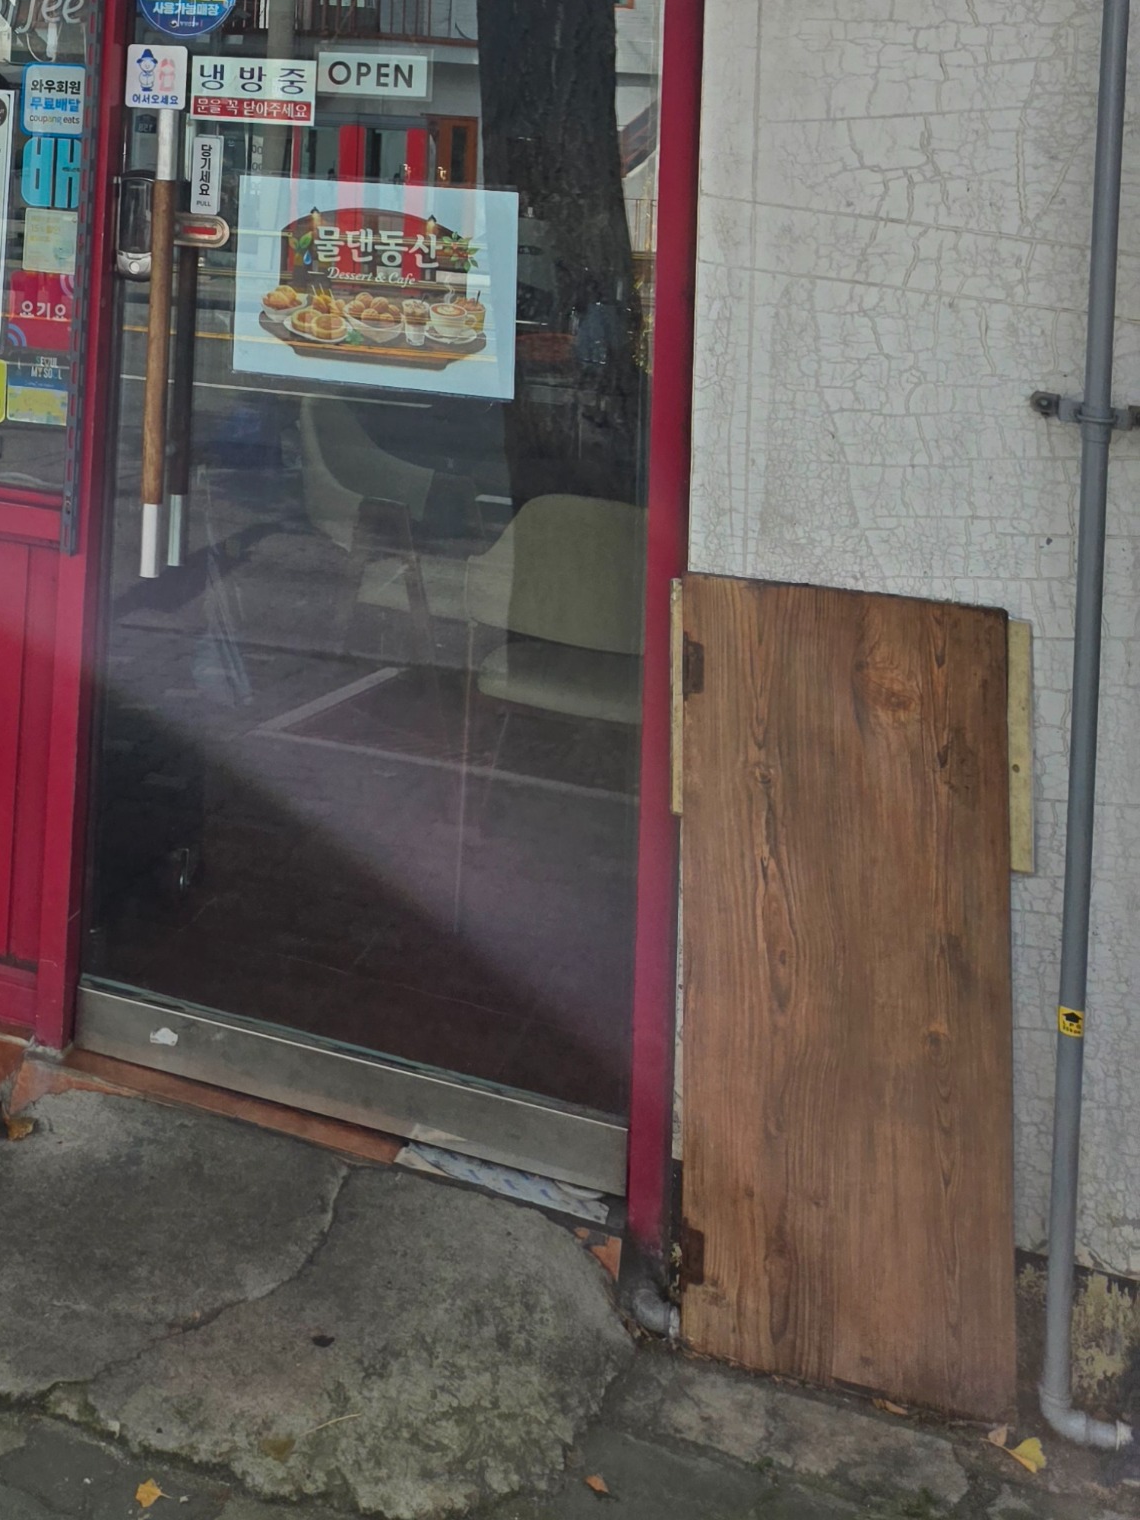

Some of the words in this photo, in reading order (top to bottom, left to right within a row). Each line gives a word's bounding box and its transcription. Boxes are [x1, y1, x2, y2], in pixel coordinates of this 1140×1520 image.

[152, 2, 220, 16] 사용가능매장
[199, 63, 307, 95] 냉방중
[328, 61, 413, 88] OPEN
[30, 79, 81, 95] 와우회원
[30, 97, 80, 113] 무료배달
[132, 93, 179, 105] 어서오세요
[196, 98, 222, 113] 문을
[225, 99, 239, 115] 꼭
[243, 102, 307, 118] 닫아주세요
[63, 115, 80, 124] eats
[199, 144, 213, 196] 당기세요
[314, 226, 443, 268] 물댄동산
[327, 267, 372, 281] Dessert
[375, 272, 385, 282] &
[388, 273, 416, 288] Cafe
[20, 300, 67, 320] 요기요
